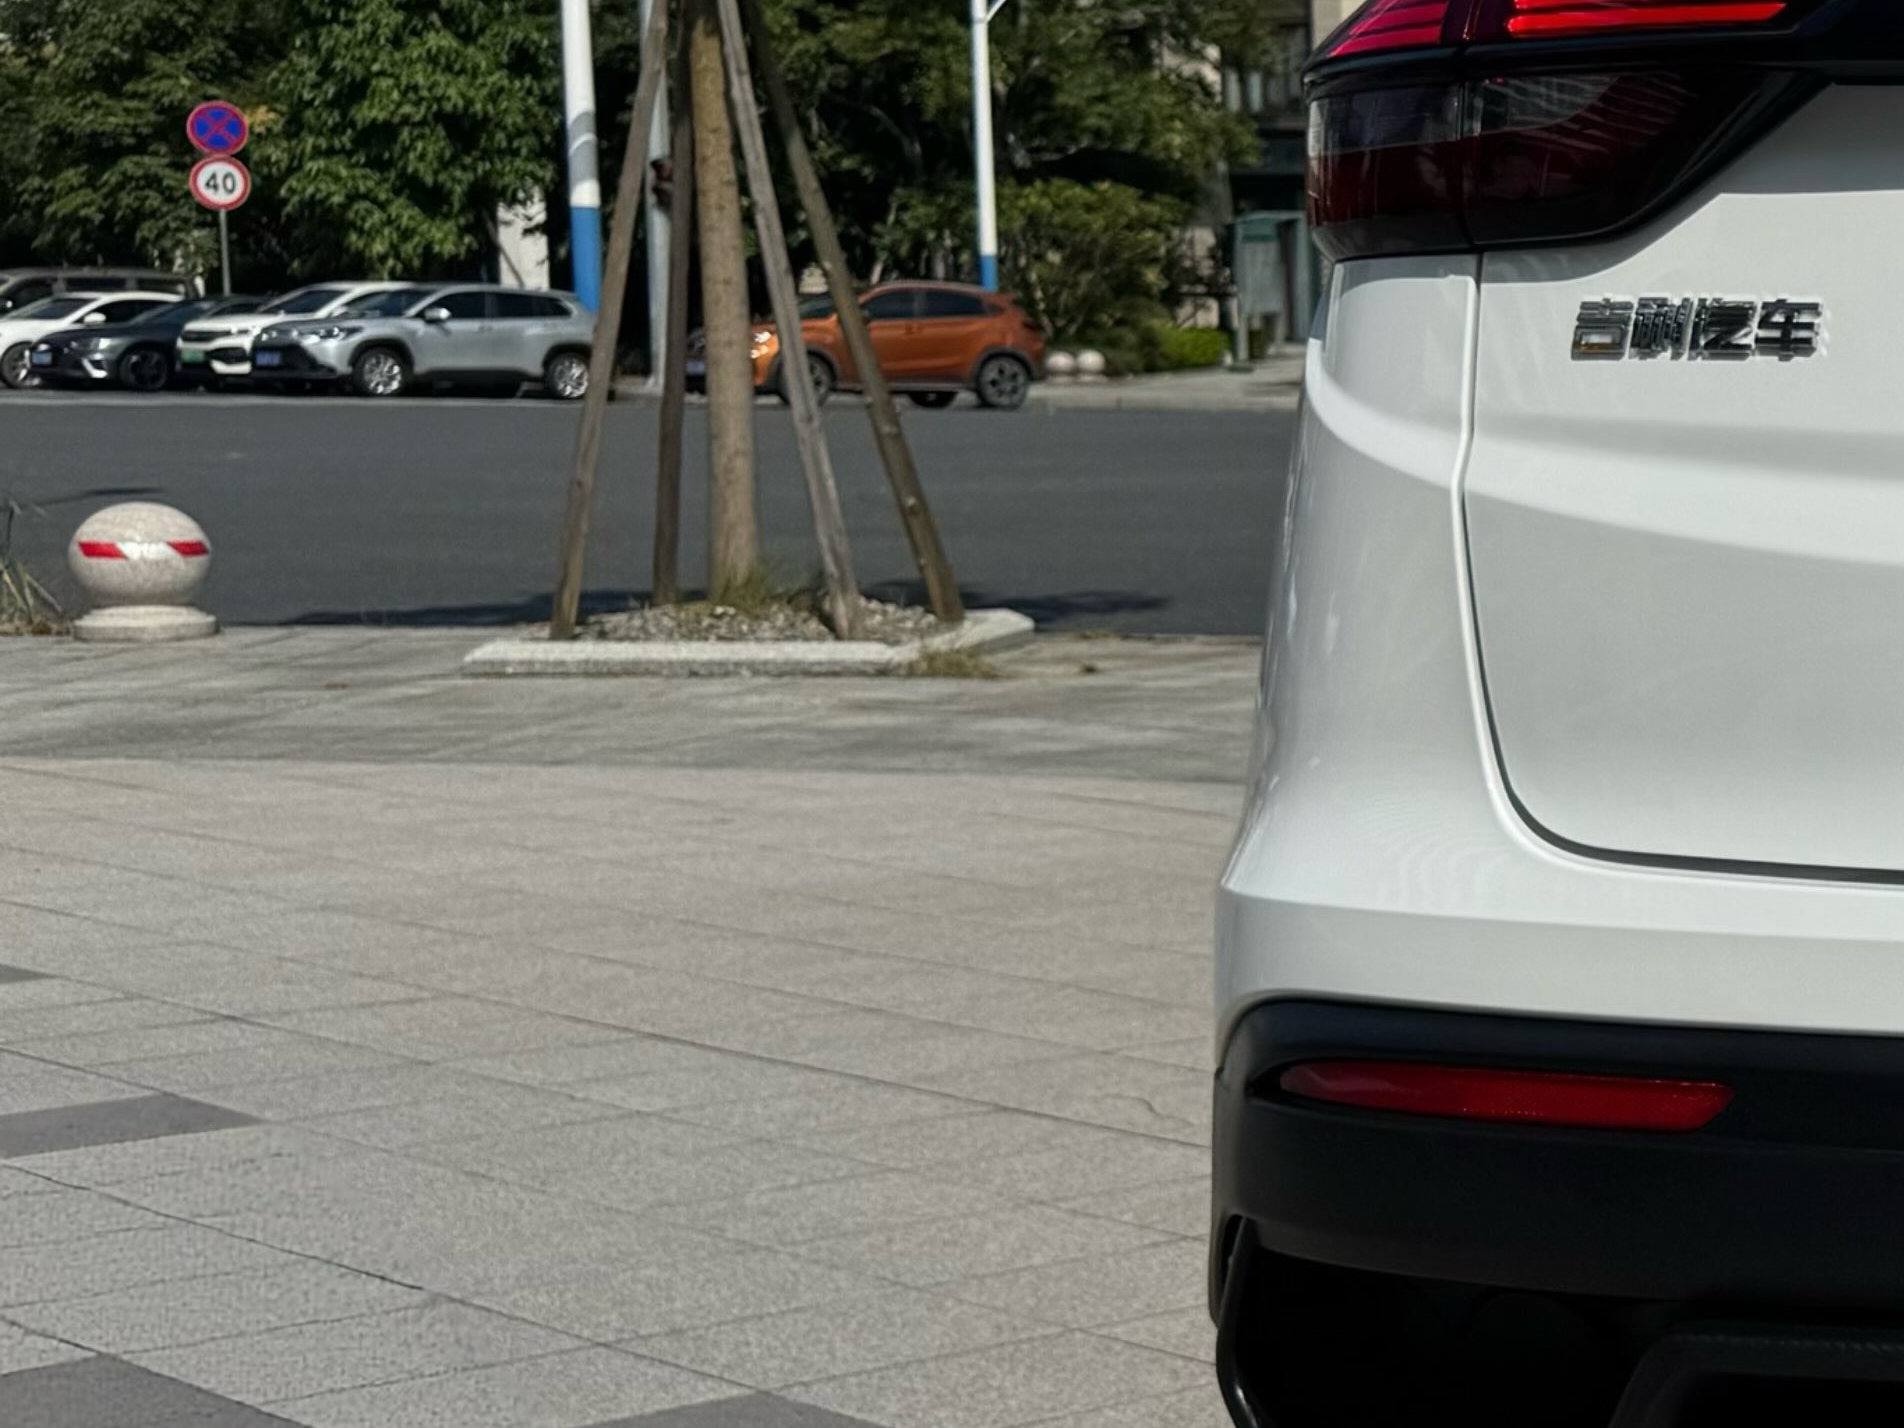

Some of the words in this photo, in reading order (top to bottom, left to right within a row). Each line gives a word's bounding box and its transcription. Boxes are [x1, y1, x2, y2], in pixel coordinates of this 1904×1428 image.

[204, 171, 237, 194] 40
[1570, 297, 1823, 362] 吉利汽车
